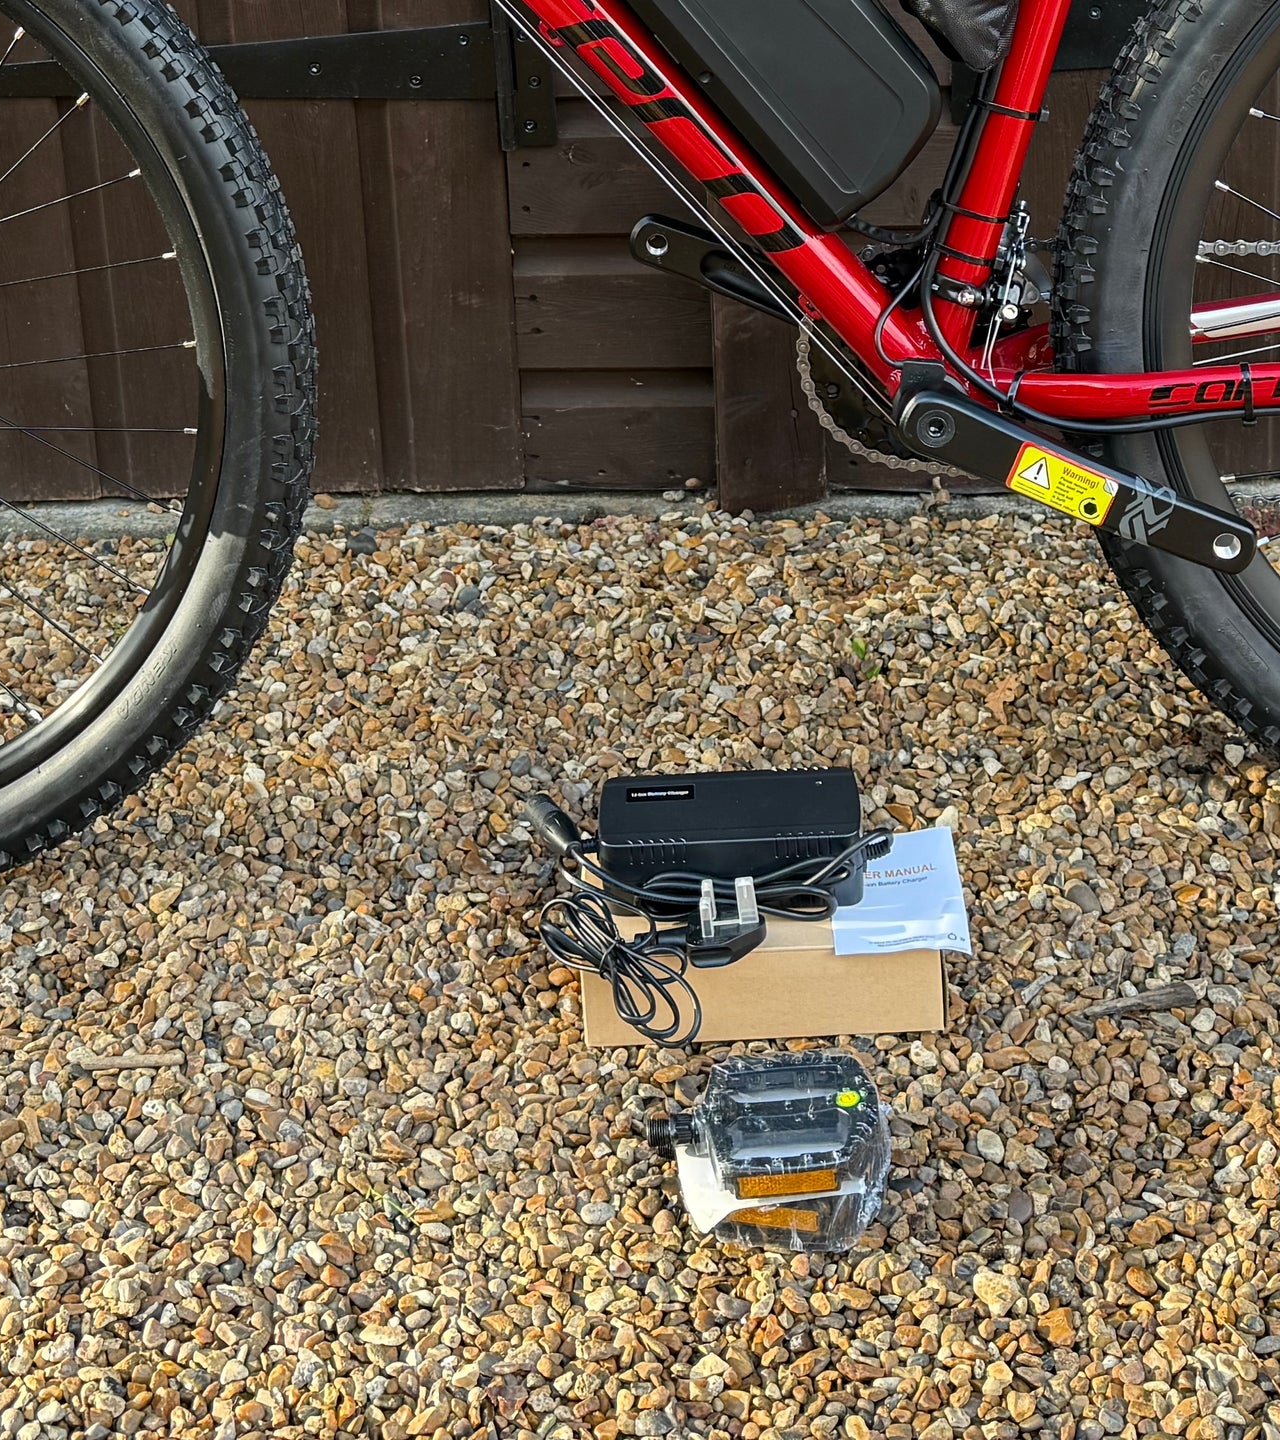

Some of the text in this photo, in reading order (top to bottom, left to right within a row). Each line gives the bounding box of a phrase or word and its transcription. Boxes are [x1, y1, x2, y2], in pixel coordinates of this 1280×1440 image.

[1062, 466, 1100, 489] Warning!
[118, 645, 180, 721] KENDA
[864, 863, 937, 879] ER MANUAL
[878, 879, 901, 887] Battery
[902, 876, 928, 884] Charger
